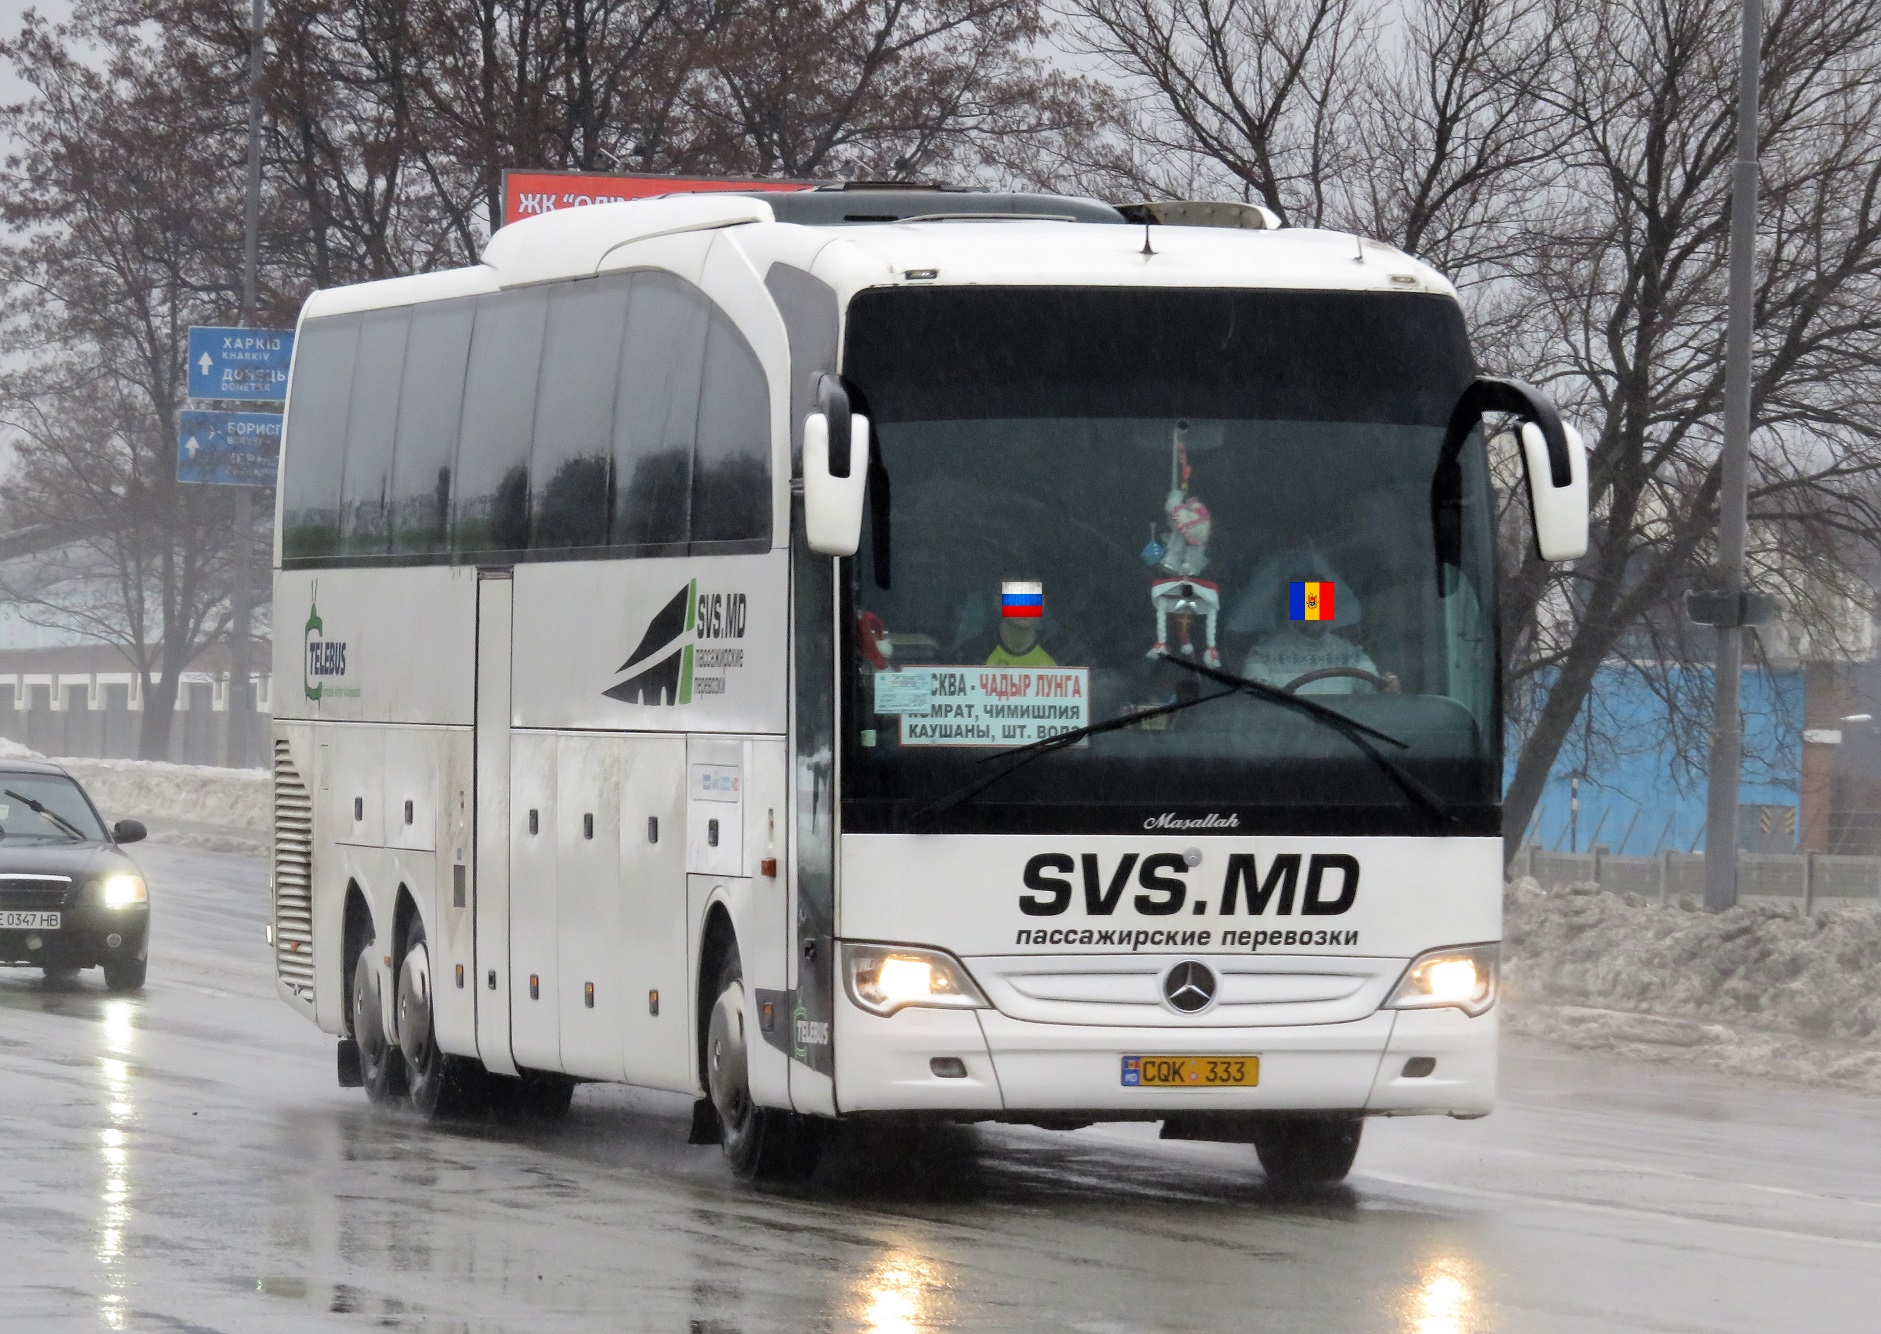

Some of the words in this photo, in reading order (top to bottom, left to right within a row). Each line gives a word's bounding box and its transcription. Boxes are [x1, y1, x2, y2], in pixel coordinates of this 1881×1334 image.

[223, 337, 281, 351] ХАРКІВ
[222, 351, 270, 361] KHARKIV
[697, 593, 747, 639] SVS.MD
[309, 642, 347, 676] TELEBUS
[979, 673, 1031, 701] ЧАДЫР
[1035, 674, 1083, 698] ЛУНГА
[908, 704, 979, 722] МРАТ,
[983, 704, 1080, 720] ЧИМИШЛИЯ
[908, 723, 995, 742] КАУШАНЫ,
[1002, 725, 1031, 739] ШТ.
[1018, 852, 1361, 917] SVS.MD
[7, 913, 37, 926] 0347
[40, 914, 59, 927] HB
[1015, 928, 1212, 952] пассажирские
[1221, 928, 1360, 952] перевозки
[1142, 1060, 1186, 1083] CQK
[1205, 1061, 1246, 1083] 333
